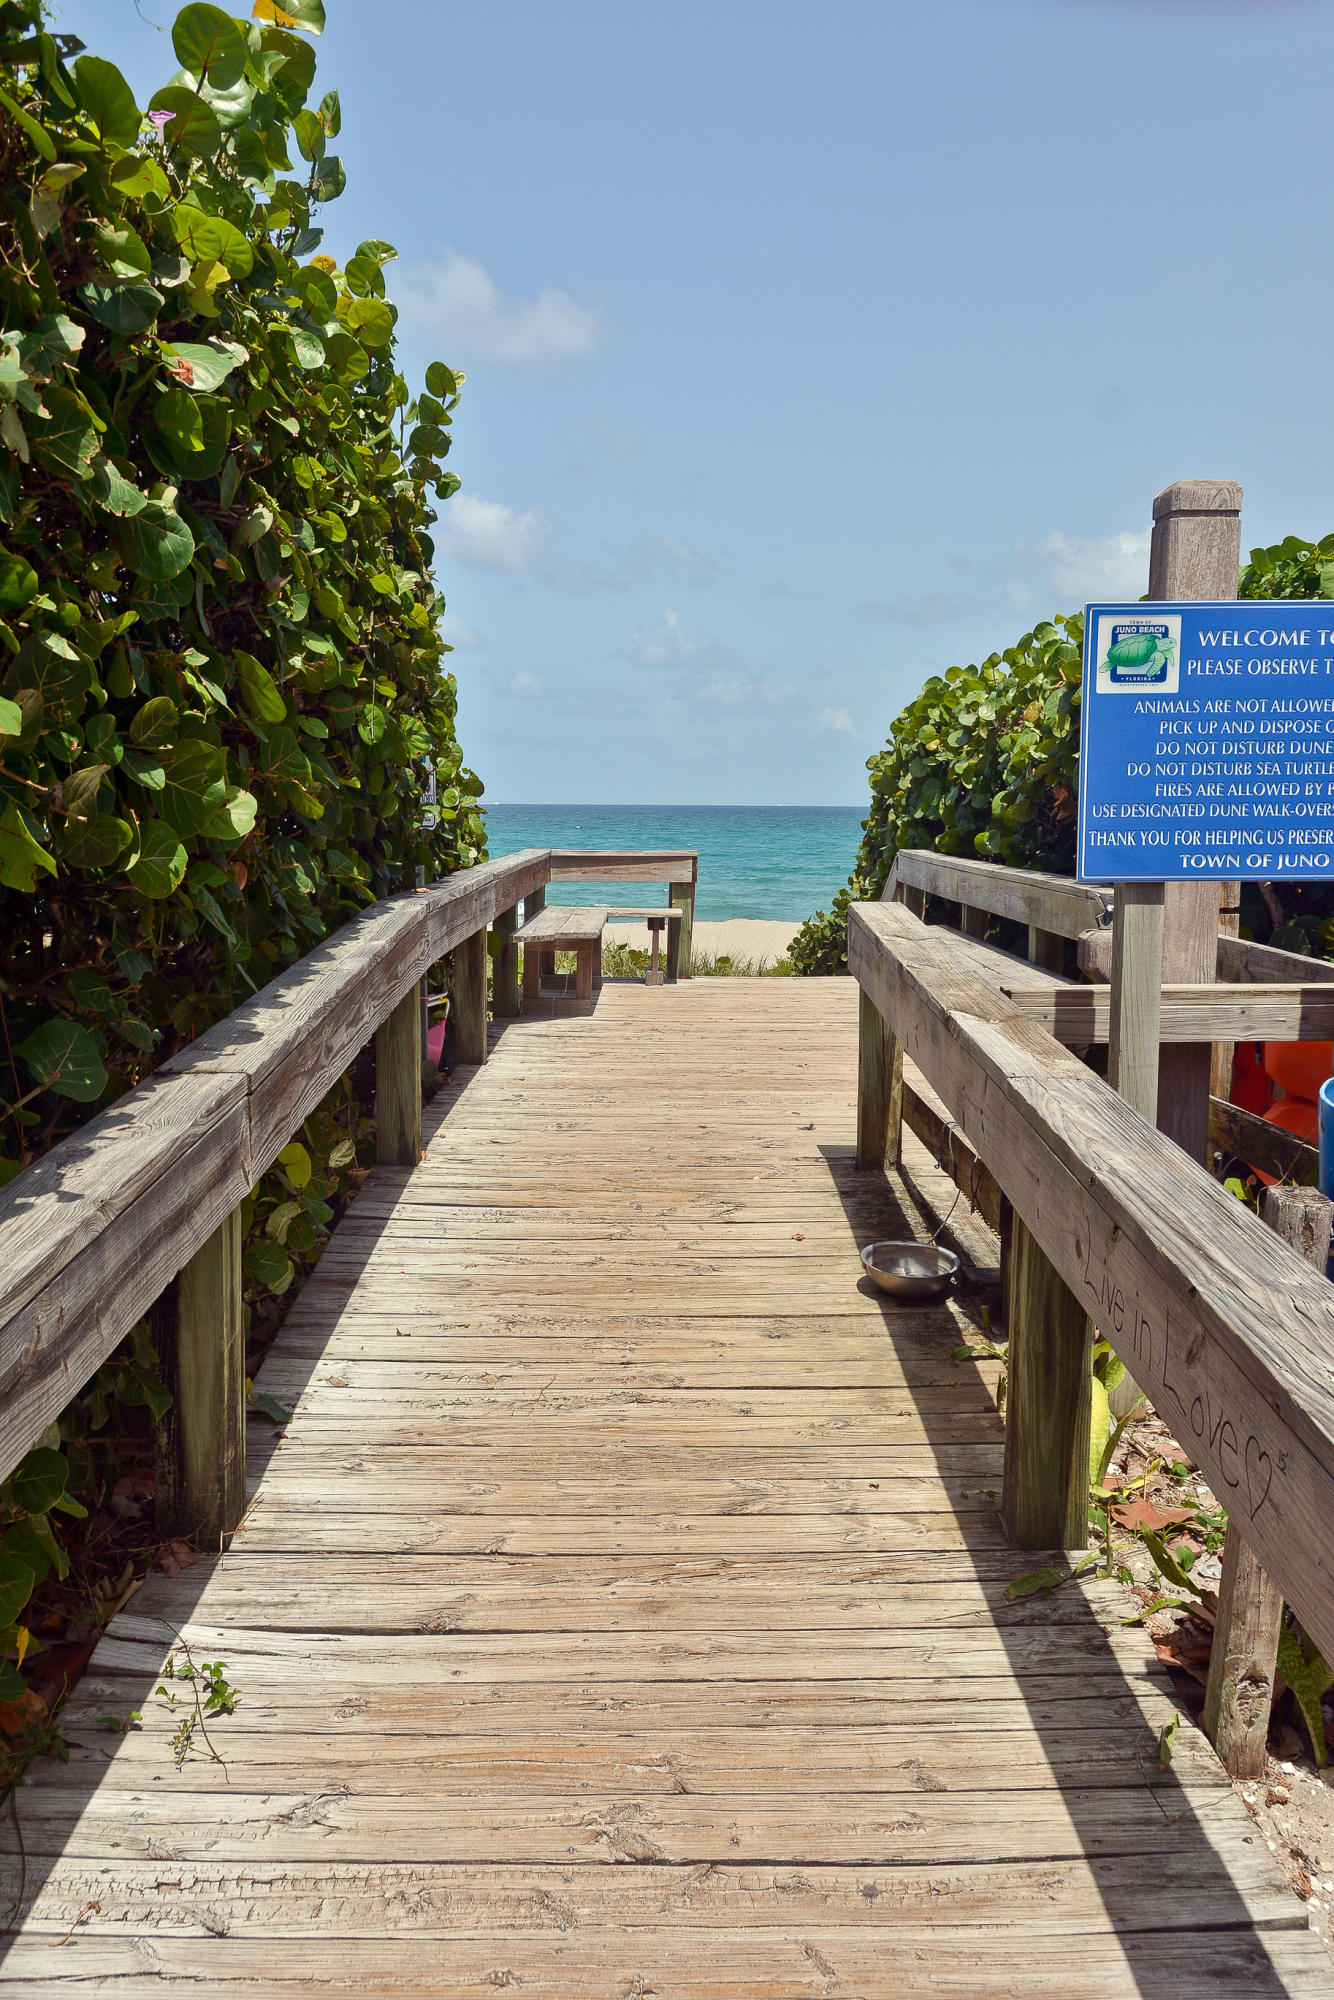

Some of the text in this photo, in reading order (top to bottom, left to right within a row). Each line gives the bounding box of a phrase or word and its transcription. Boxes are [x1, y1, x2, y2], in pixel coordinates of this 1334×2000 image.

[1115, 626, 1137, 634] JUNO
[1199, 629, 1334, 646] WELCOME T
[1188, 658, 1333, 675] PLEASE OBSERVE T
[1135, 698, 1334, 713] ANIMALS ARE NOT ALLOWE
[1160, 720, 1193, 734] PICK
[1198, 720, 1218, 734] UP
[1221, 720, 1255, 733] AND
[1260, 719, 1321, 733] DISPOSE
[1156, 741, 1180, 754] DO
[1185, 741, 1218, 754] NOT
[1223, 740, 1285, 754] DISTURB
[1128, 762, 1151, 776] DO
[1156, 762, 1187, 775] NOT
[1192, 761, 1252, 775] DISTURB
[1257, 761, 1281, 775] SEA
[1156, 782, 1192, 796] FIRES
[1196, 782, 1223, 796] ARE
[1228, 782, 1301, 795] ALLOWED
[1305, 782, 1323, 795] BY
[1093, 802, 1334, 817] USE DESIGNATED DUNE WALK-OVER
[1089, 830, 1137, 845] THANK
[1141, 830, 1170, 845] YOU
[1175, 829, 1201, 845] FOR
[1206, 829, 1264, 844] HELPING
[1268, 829, 1285, 844] US
[1180, 853, 1330, 869] TOWN OF JUNO
[1083, 1209, 1125, 1333] Live
[1133, 1290, 1153, 1371] in
[1162, 1306, 1240, 1488] Love
